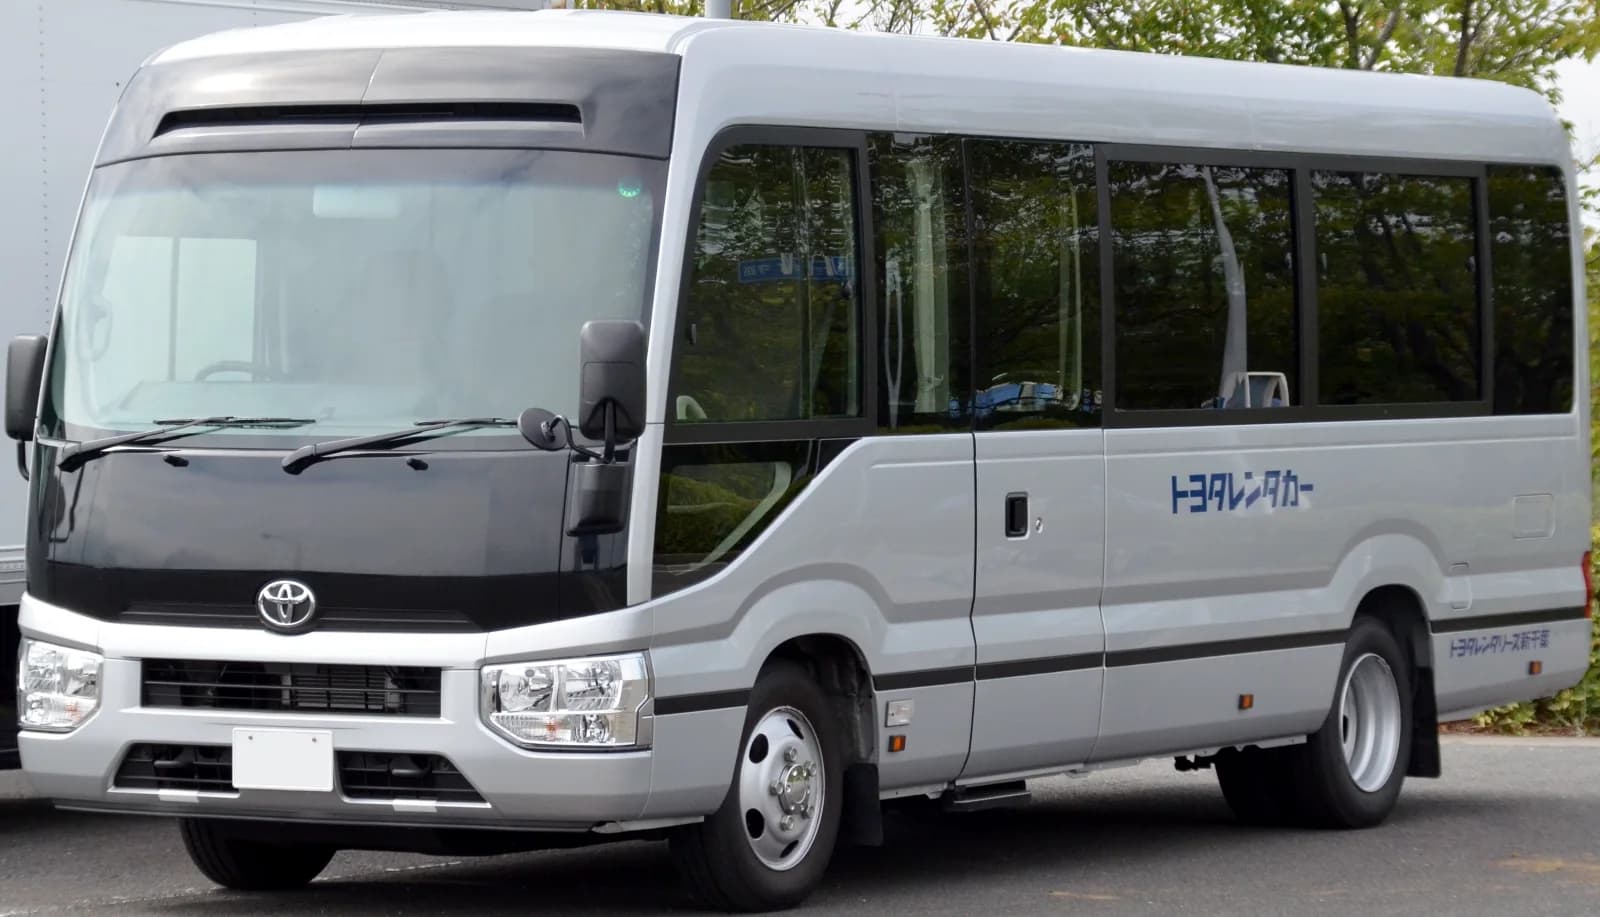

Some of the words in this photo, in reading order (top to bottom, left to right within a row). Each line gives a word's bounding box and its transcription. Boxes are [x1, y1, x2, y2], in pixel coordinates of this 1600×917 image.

[1171, 469, 1314, 514] トヨタレンタカー
